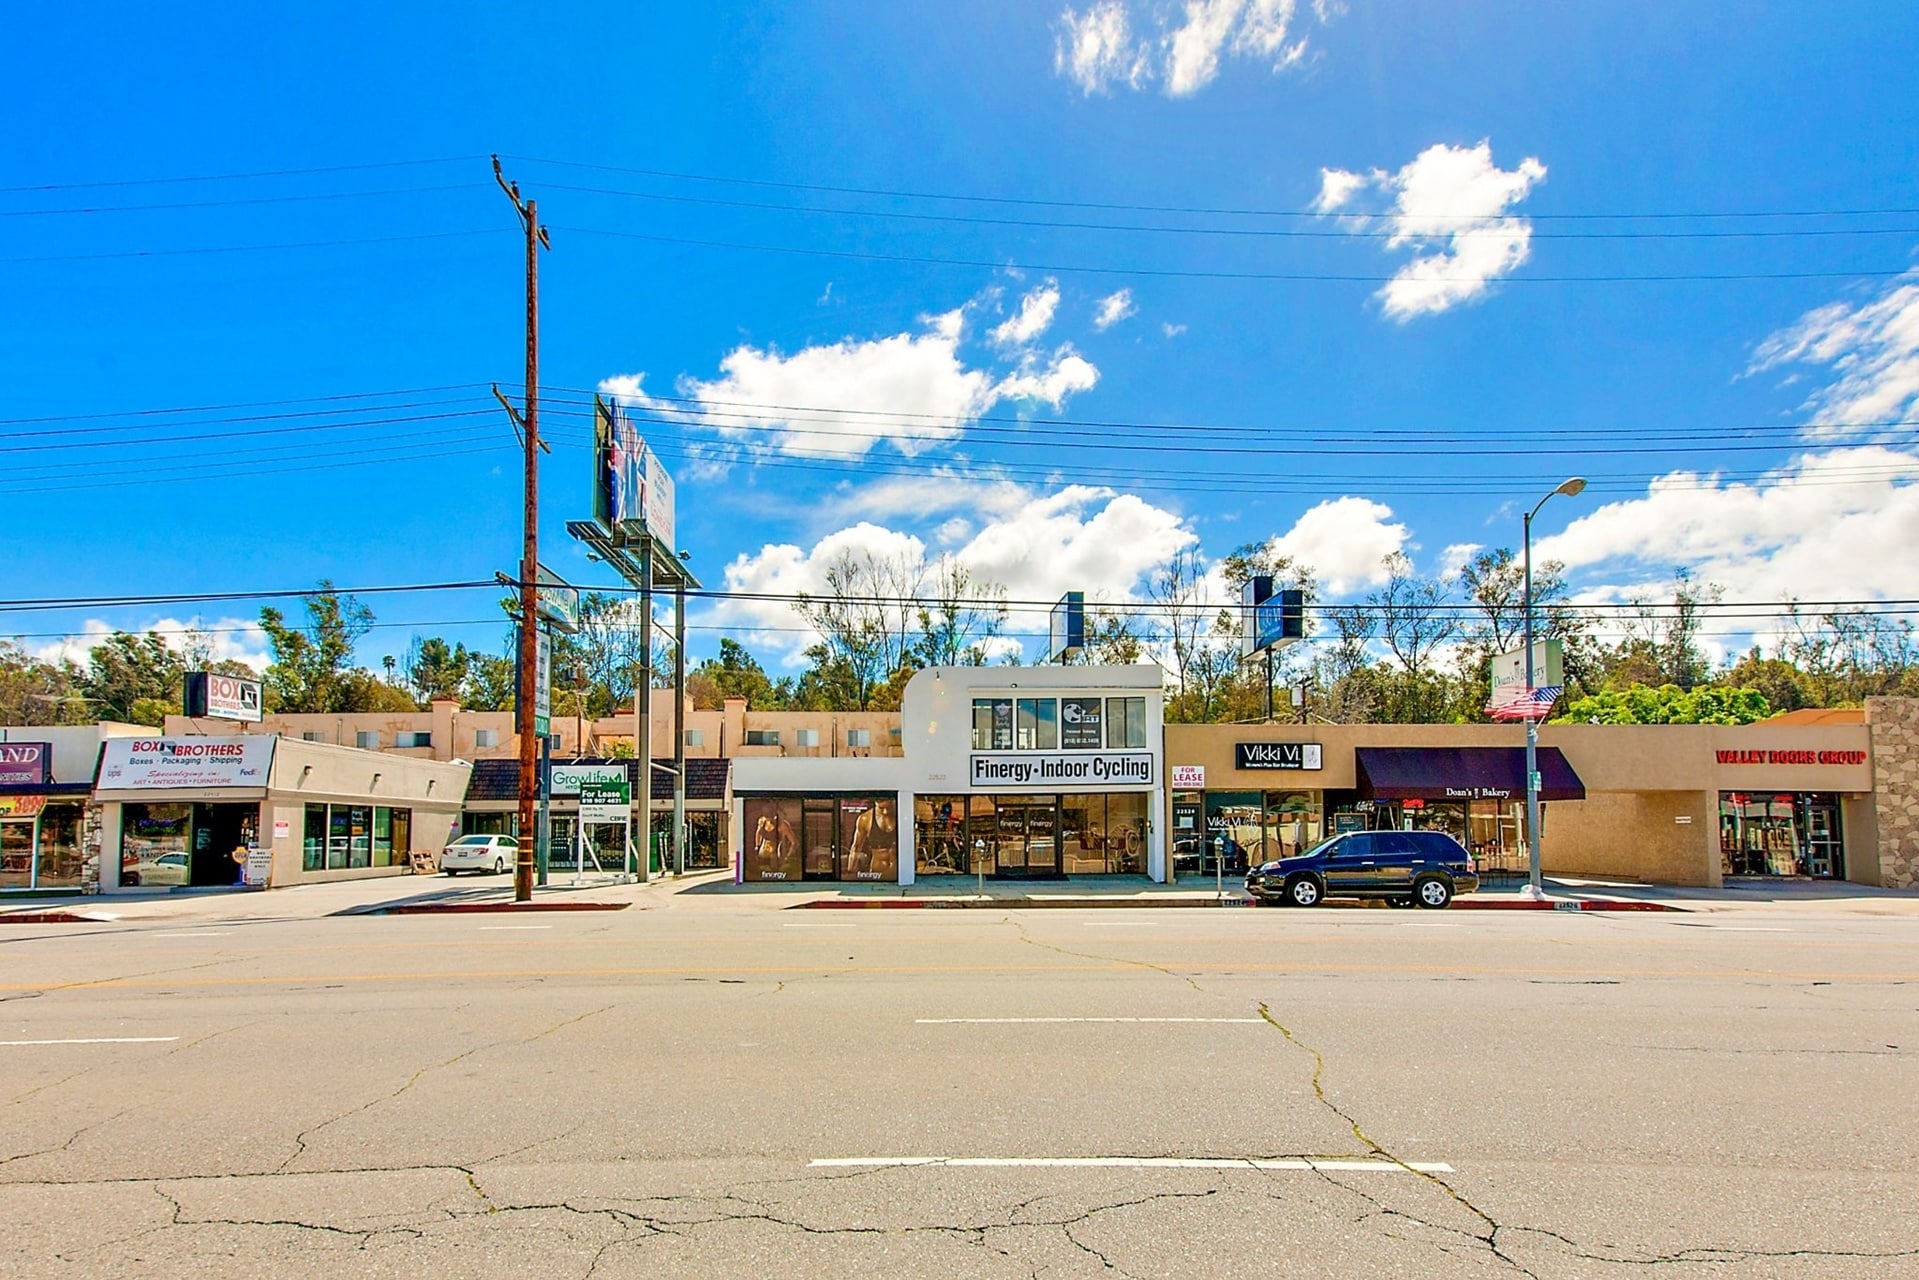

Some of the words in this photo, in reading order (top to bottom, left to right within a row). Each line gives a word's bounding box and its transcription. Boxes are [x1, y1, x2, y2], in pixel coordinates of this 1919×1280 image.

[211, 677, 240, 700] BOX
[132, 741, 160, 753] BOX
[175, 743, 244, 756] BROTHERS
[1243, 744, 1280, 761] Vikki
[129, 757, 153, 765] Boxes
[161, 757, 201, 766] Packaging
[209, 756, 243, 765] Shipping
[1716, 750, 1767, 764] VALLEY
[1769, 750, 1816, 764] DOORS
[1818, 750, 1867, 764] GROUP
[975, 759, 1032, 782] Finergy
[1040, 758, 1089, 778] Indoor
[1093, 756, 1149, 780] Cycling
[1173, 773, 1203, 781] LEASE
[582, 790, 596, 798] For
[597, 790, 621, 798] Lease
[1446, 787, 1473, 797] Doan's
[1482, 787, 1511, 798] Bakery
[1206, 816, 1230, 827] Vikki
[762, 871, 787, 879] finergy
[857, 871, 882, 879] finergy
